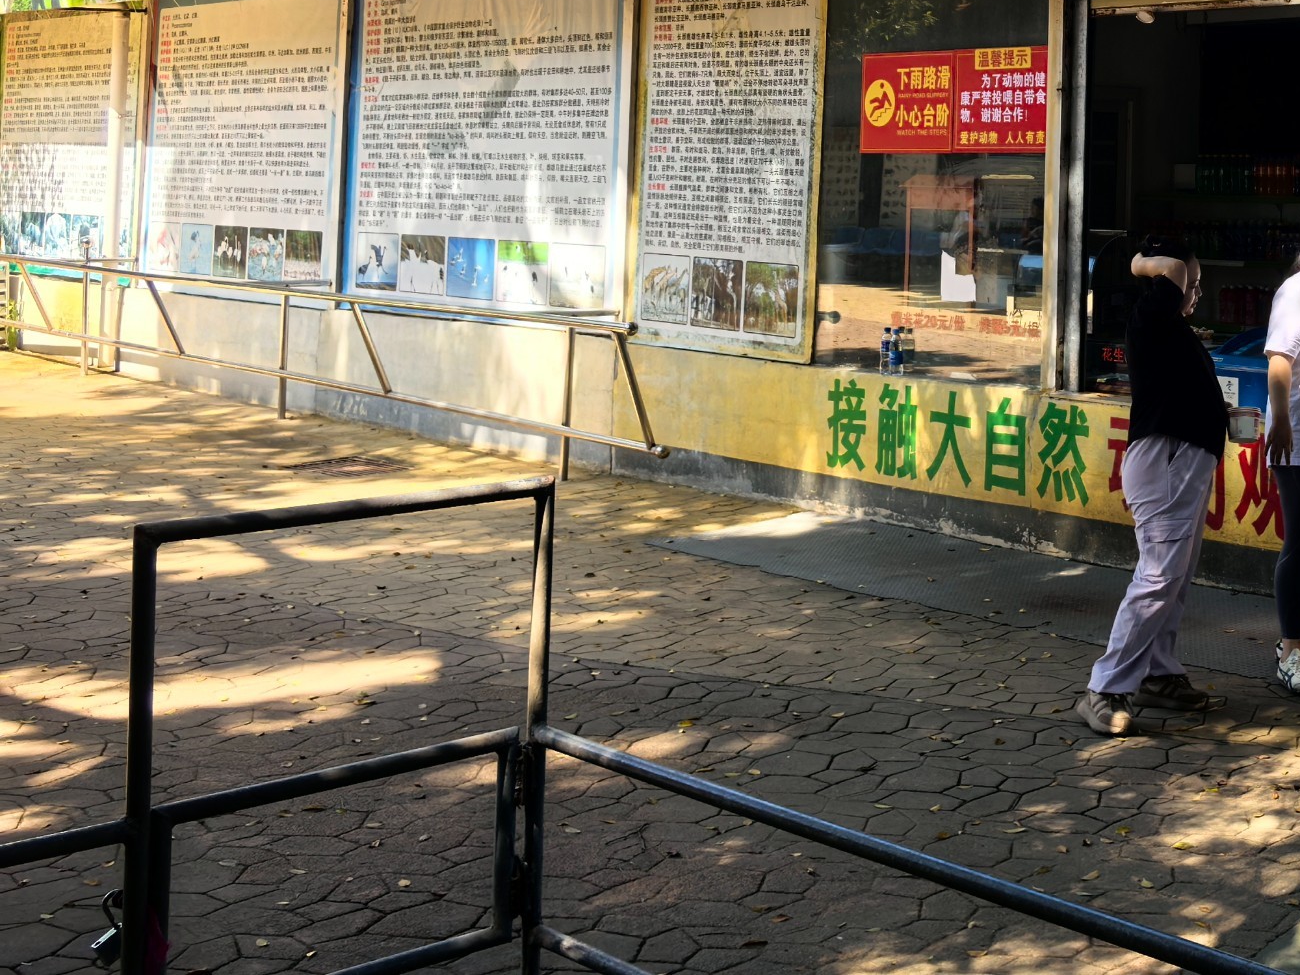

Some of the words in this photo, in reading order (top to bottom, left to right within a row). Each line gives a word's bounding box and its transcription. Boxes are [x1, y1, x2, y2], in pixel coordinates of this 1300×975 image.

[977, 49, 1029, 68] 温馨提示
[897, 65, 951, 90] 下雨路滑
[981, 71, 1046, 89] 为了动物的健
[960, 89, 1047, 106] 康严禁投喂自带食
[895, 103, 950, 128] 小心台阶
[959, 131, 998, 145] 爱护动物
[1005, 130, 1046, 145] 人人有责
[825, 378, 1091, 507] 接触大自然
